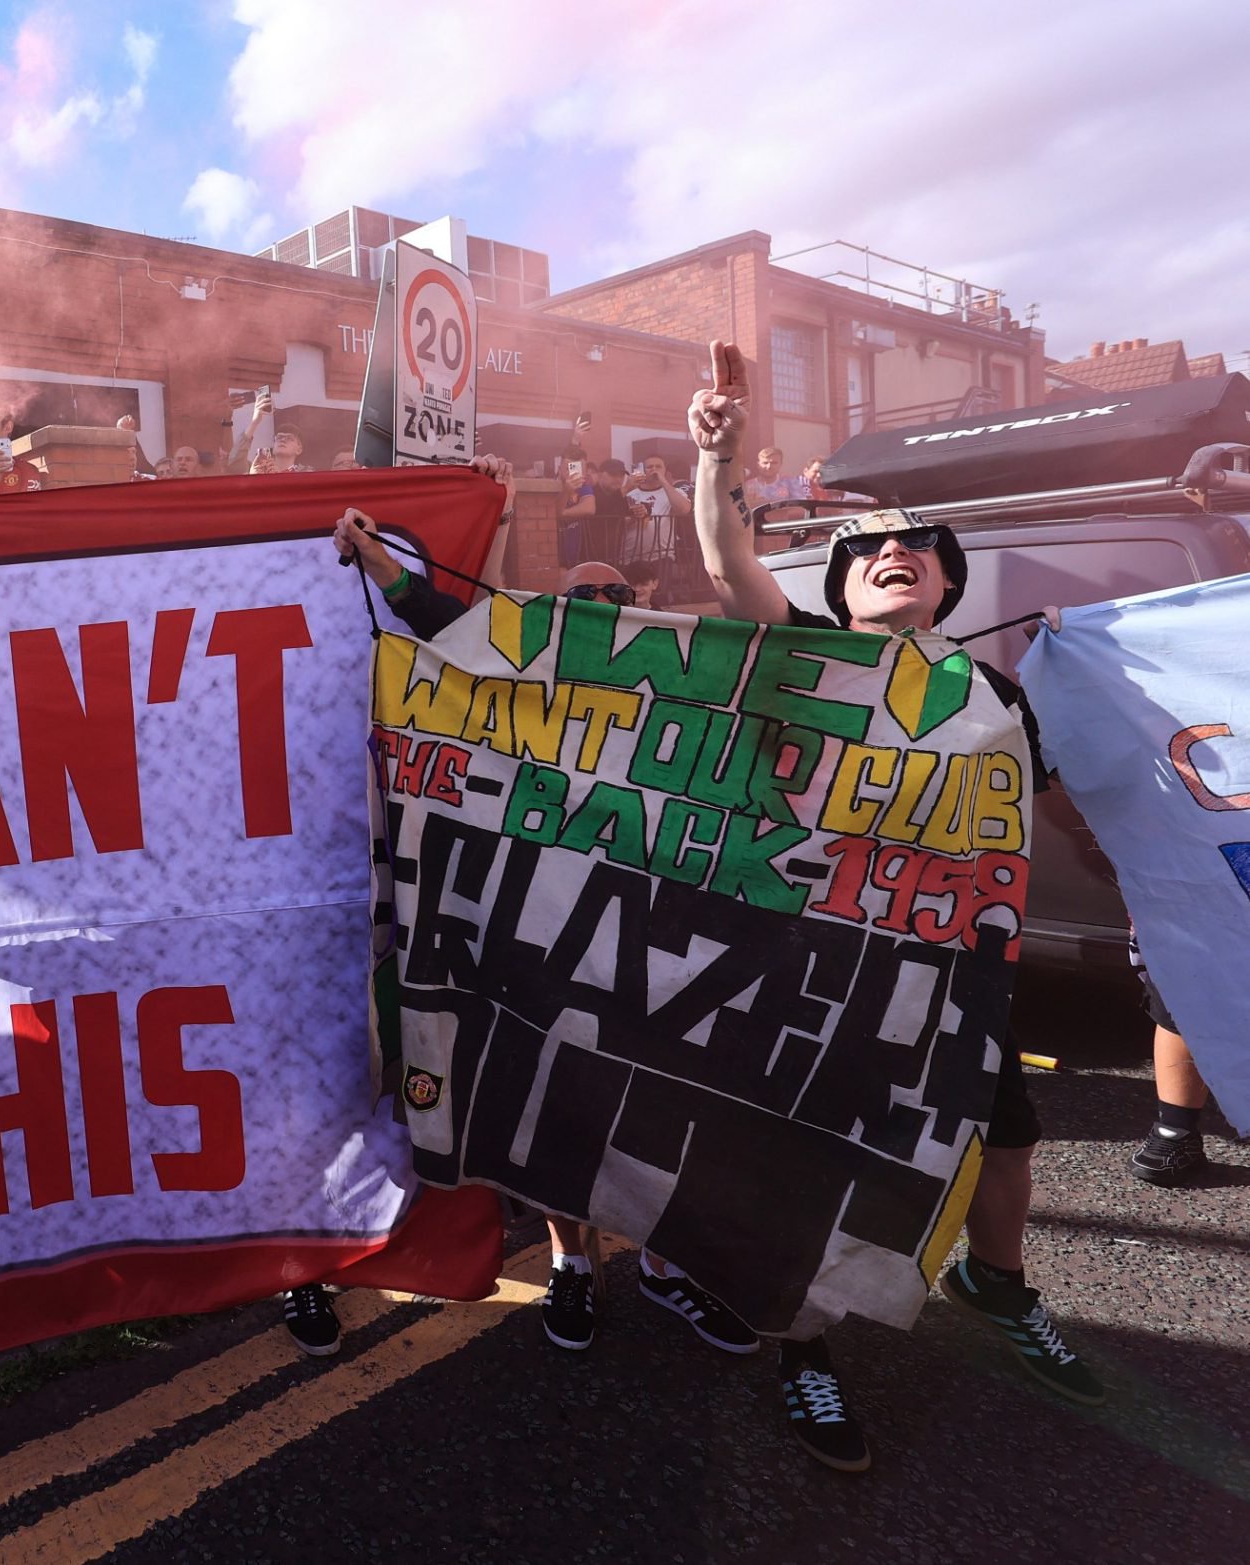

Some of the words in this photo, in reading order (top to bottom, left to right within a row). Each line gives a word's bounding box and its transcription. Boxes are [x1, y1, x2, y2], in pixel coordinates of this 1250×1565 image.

[415, 307, 462, 371] 20
[477, 348, 523, 375] AIZE
[404, 404, 465, 452] ZONE
[904, 404, 1119, 446] TENTBOX
[555, 597, 887, 741] WE
[372, 629, 644, 773] WANT
[628, 698, 825, 826] OUR
[817, 741, 1024, 856] CLUB
[810, 836, 1030, 961] 1958
